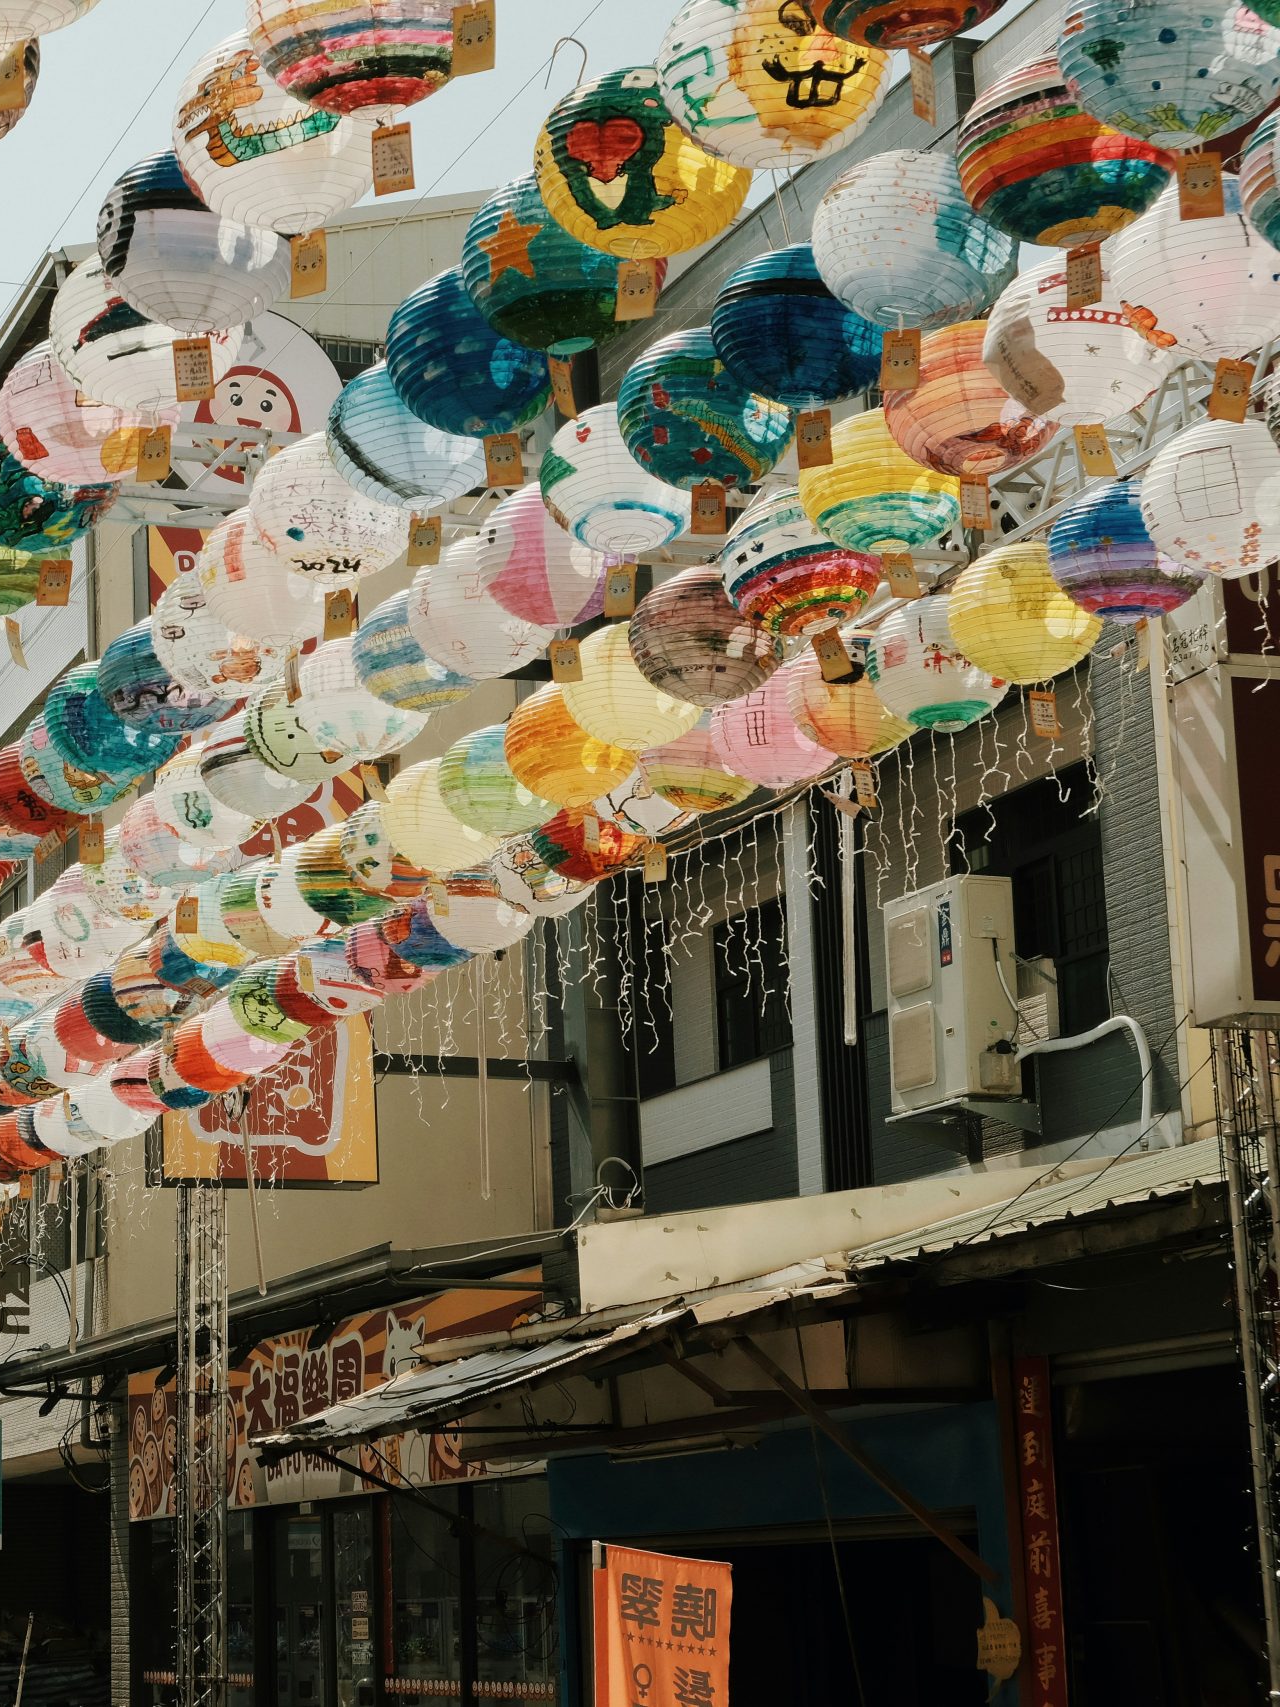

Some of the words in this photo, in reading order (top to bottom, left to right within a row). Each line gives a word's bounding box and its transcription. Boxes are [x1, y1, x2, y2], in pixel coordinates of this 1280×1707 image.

[1019, 1376, 1059, 1707] 運到庭前喜事
